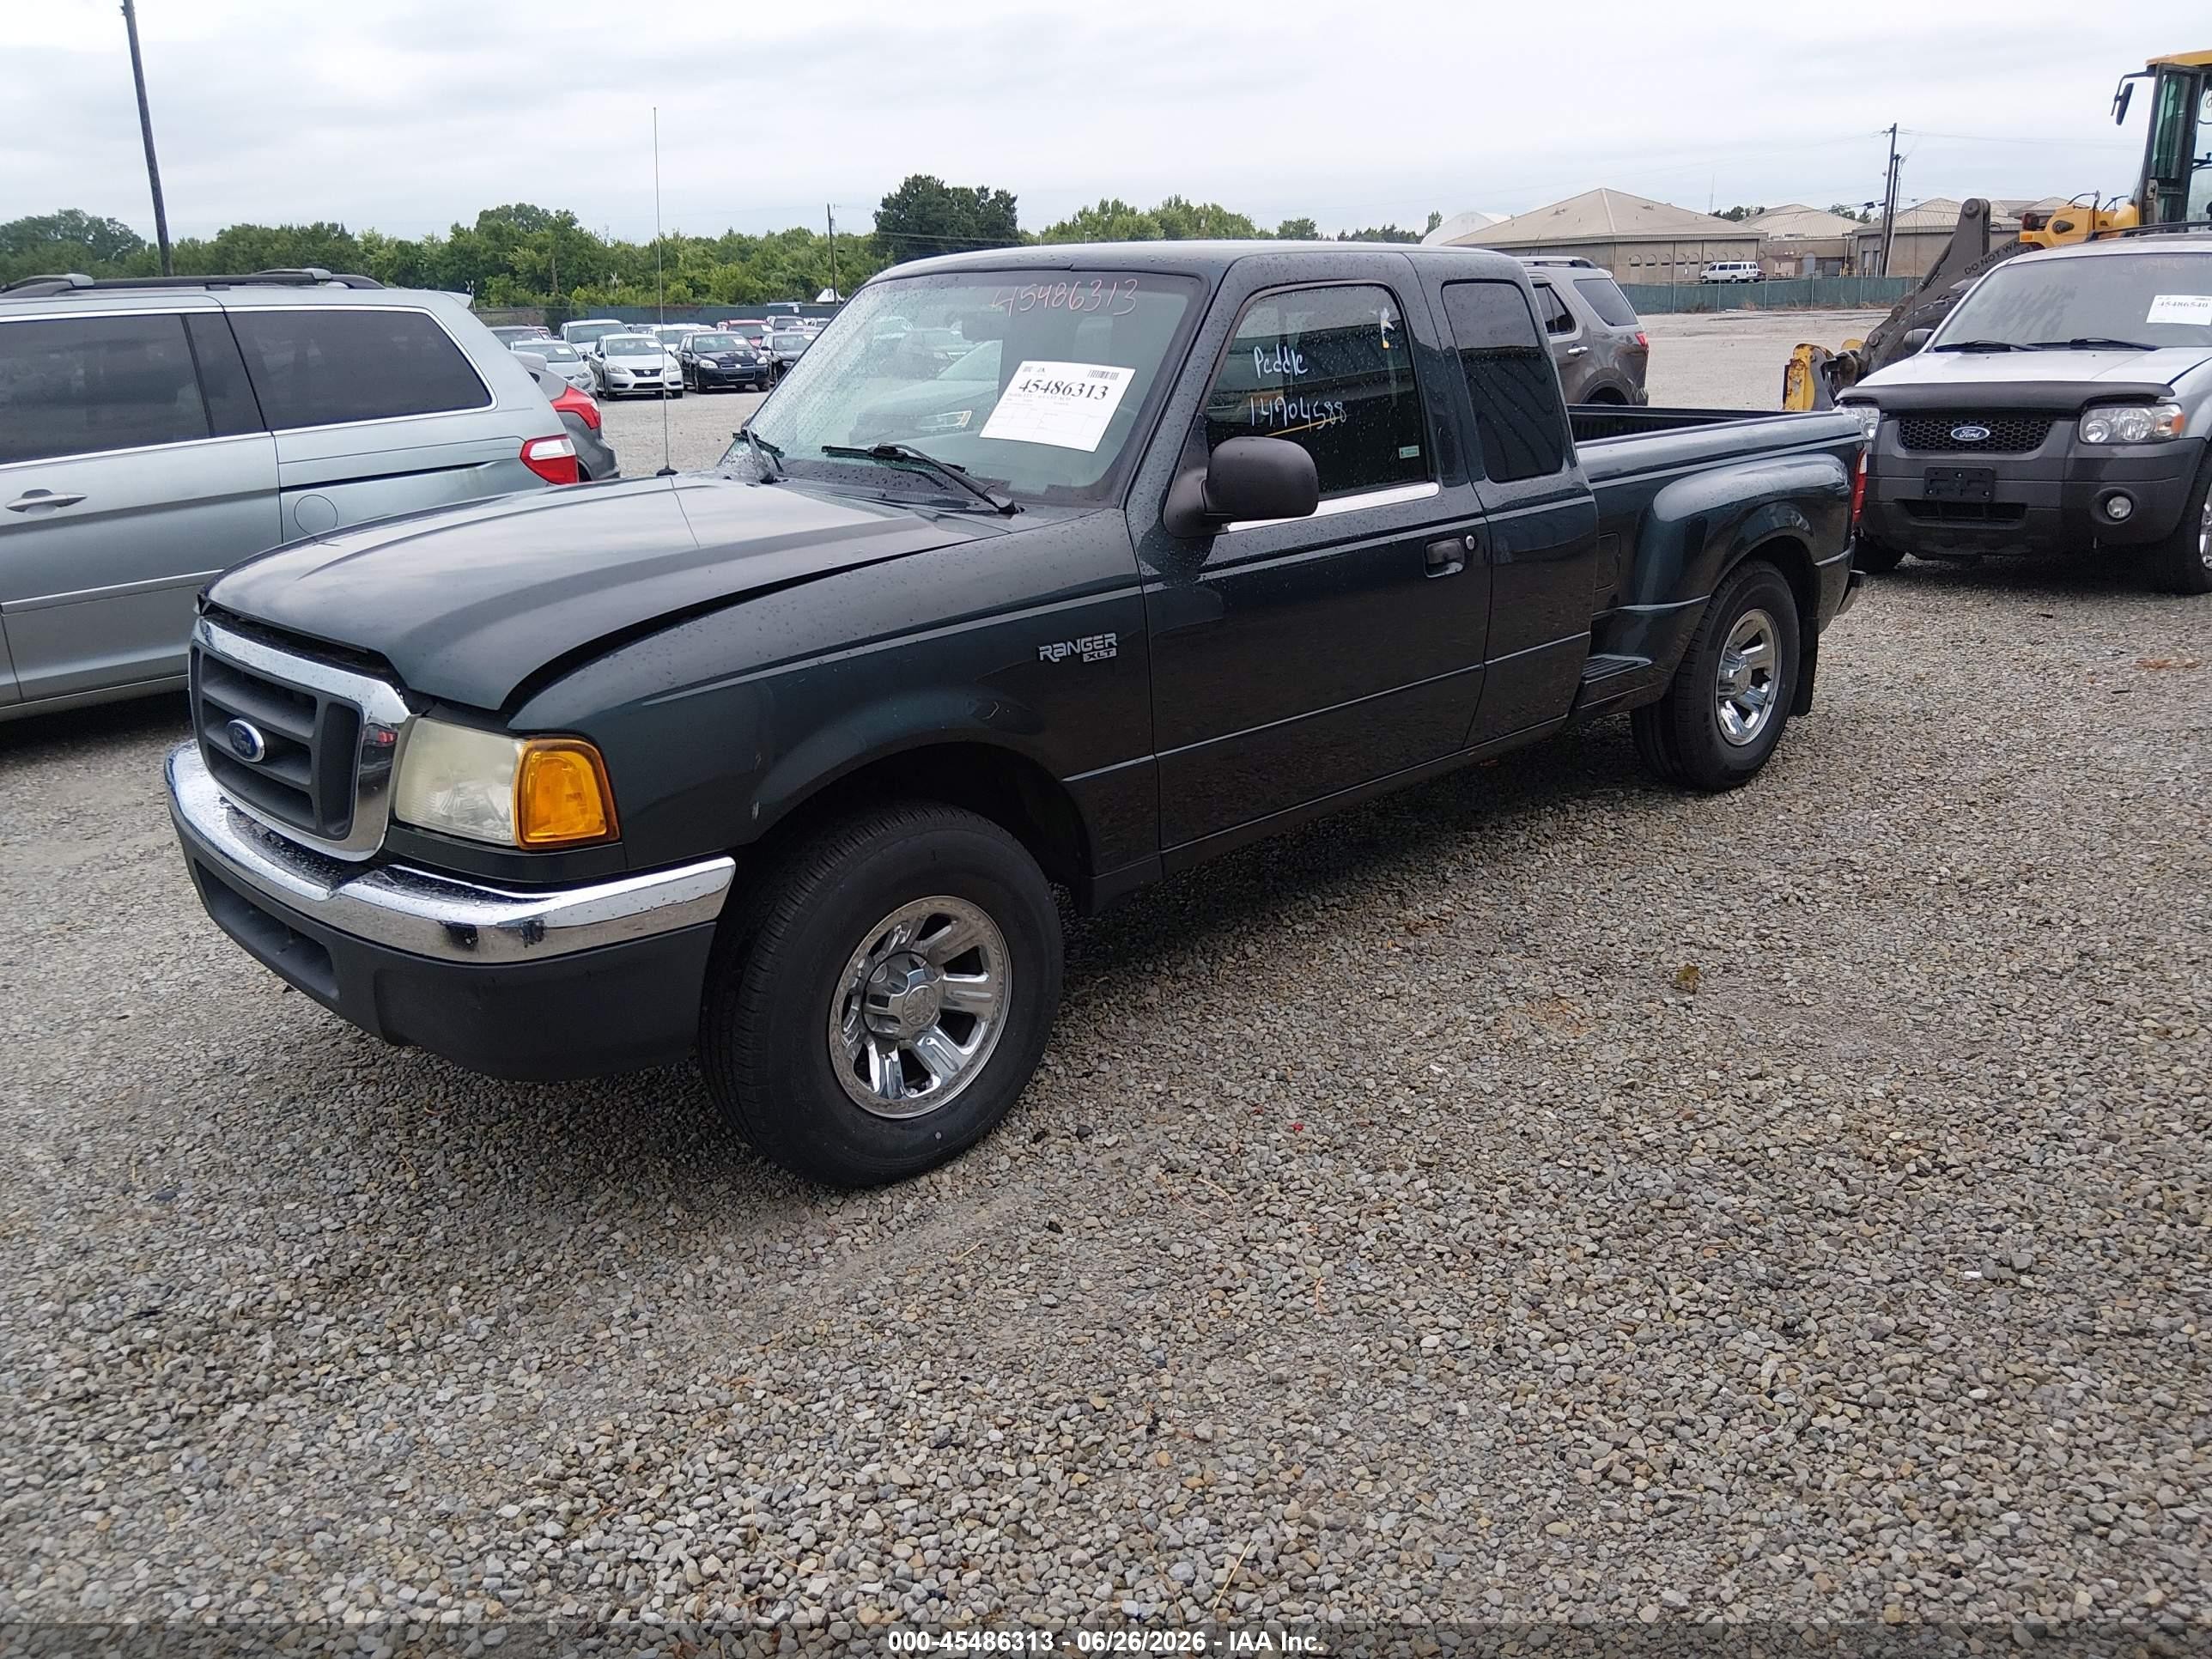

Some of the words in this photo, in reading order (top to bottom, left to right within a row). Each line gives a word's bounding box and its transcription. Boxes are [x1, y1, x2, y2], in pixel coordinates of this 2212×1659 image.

[1964, 263, 1979, 275] DO
[1980, 250, 2002, 266] NOT
[989, 279, 1139, 317] 45486313
[1253, 343, 1309, 379] Peddle
[1018, 379, 1109, 400] 45486313
[1959, 428, 1982, 439] Ford
